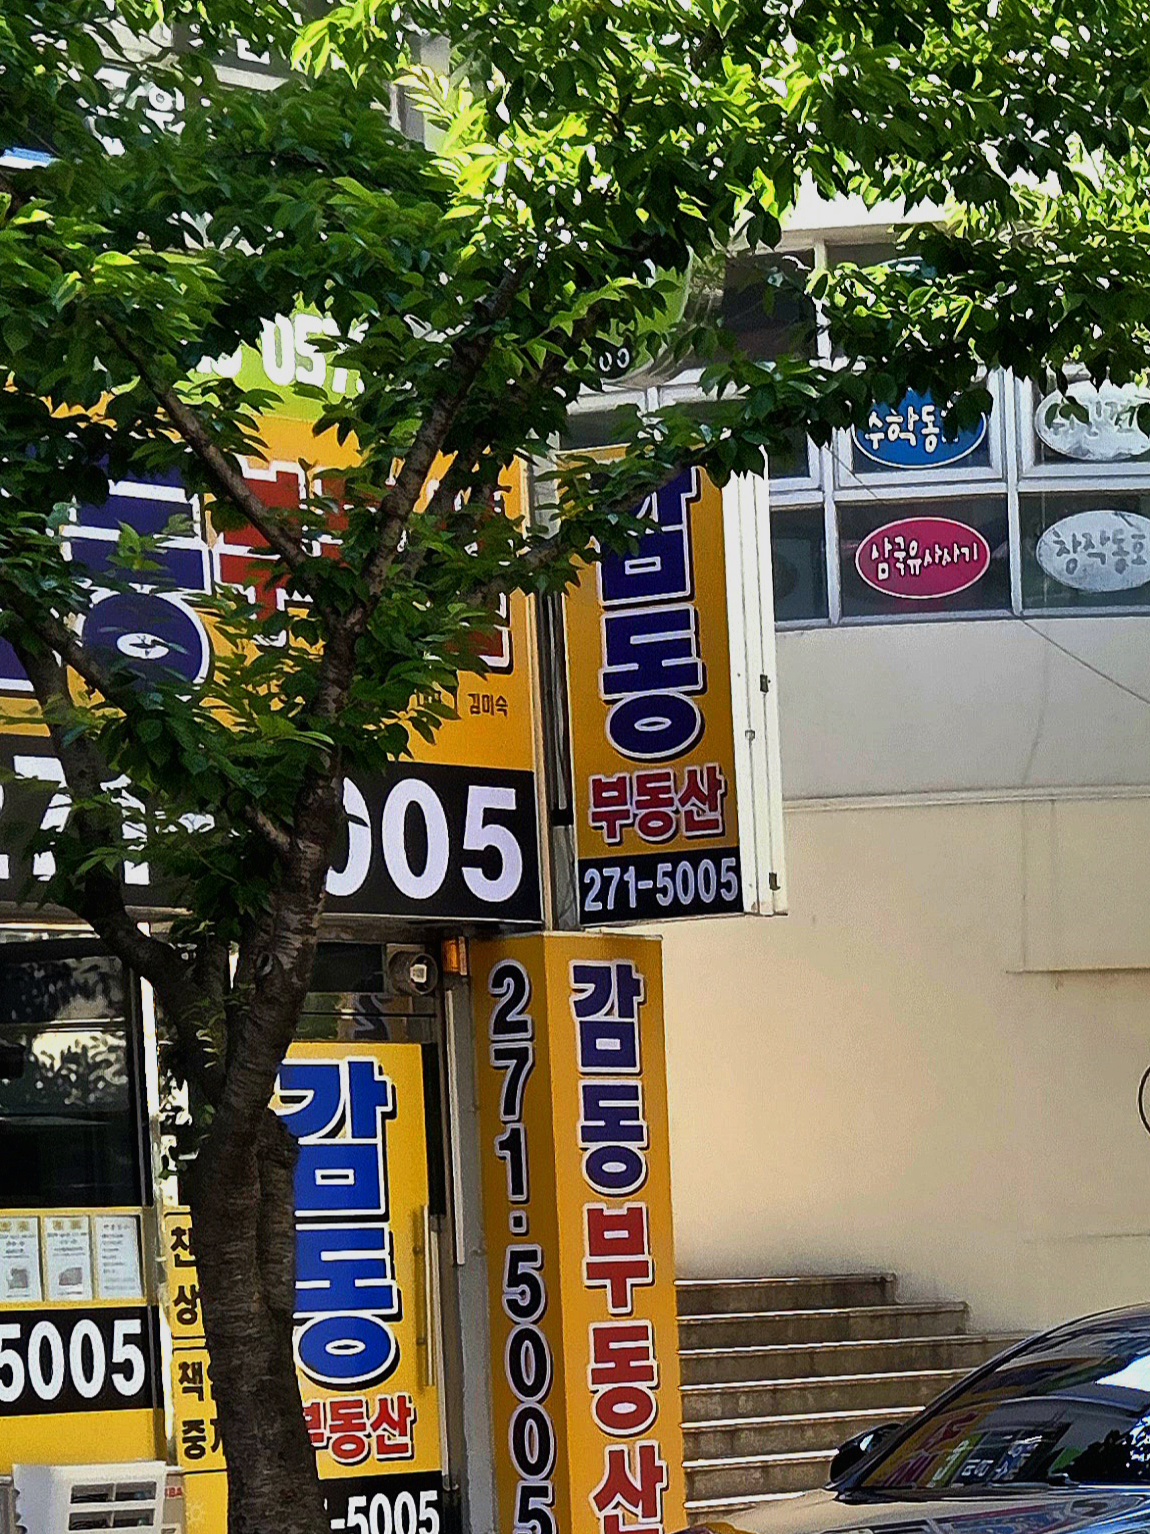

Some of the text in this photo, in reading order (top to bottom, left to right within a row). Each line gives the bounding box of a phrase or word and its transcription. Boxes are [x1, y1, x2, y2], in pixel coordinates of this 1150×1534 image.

[468, 692, 509, 718] 김미숙
[588, 761, 729, 846] 부동산
[583, 856, 739, 913] 271-5005
[0, 1318, 146, 1403] 5005
